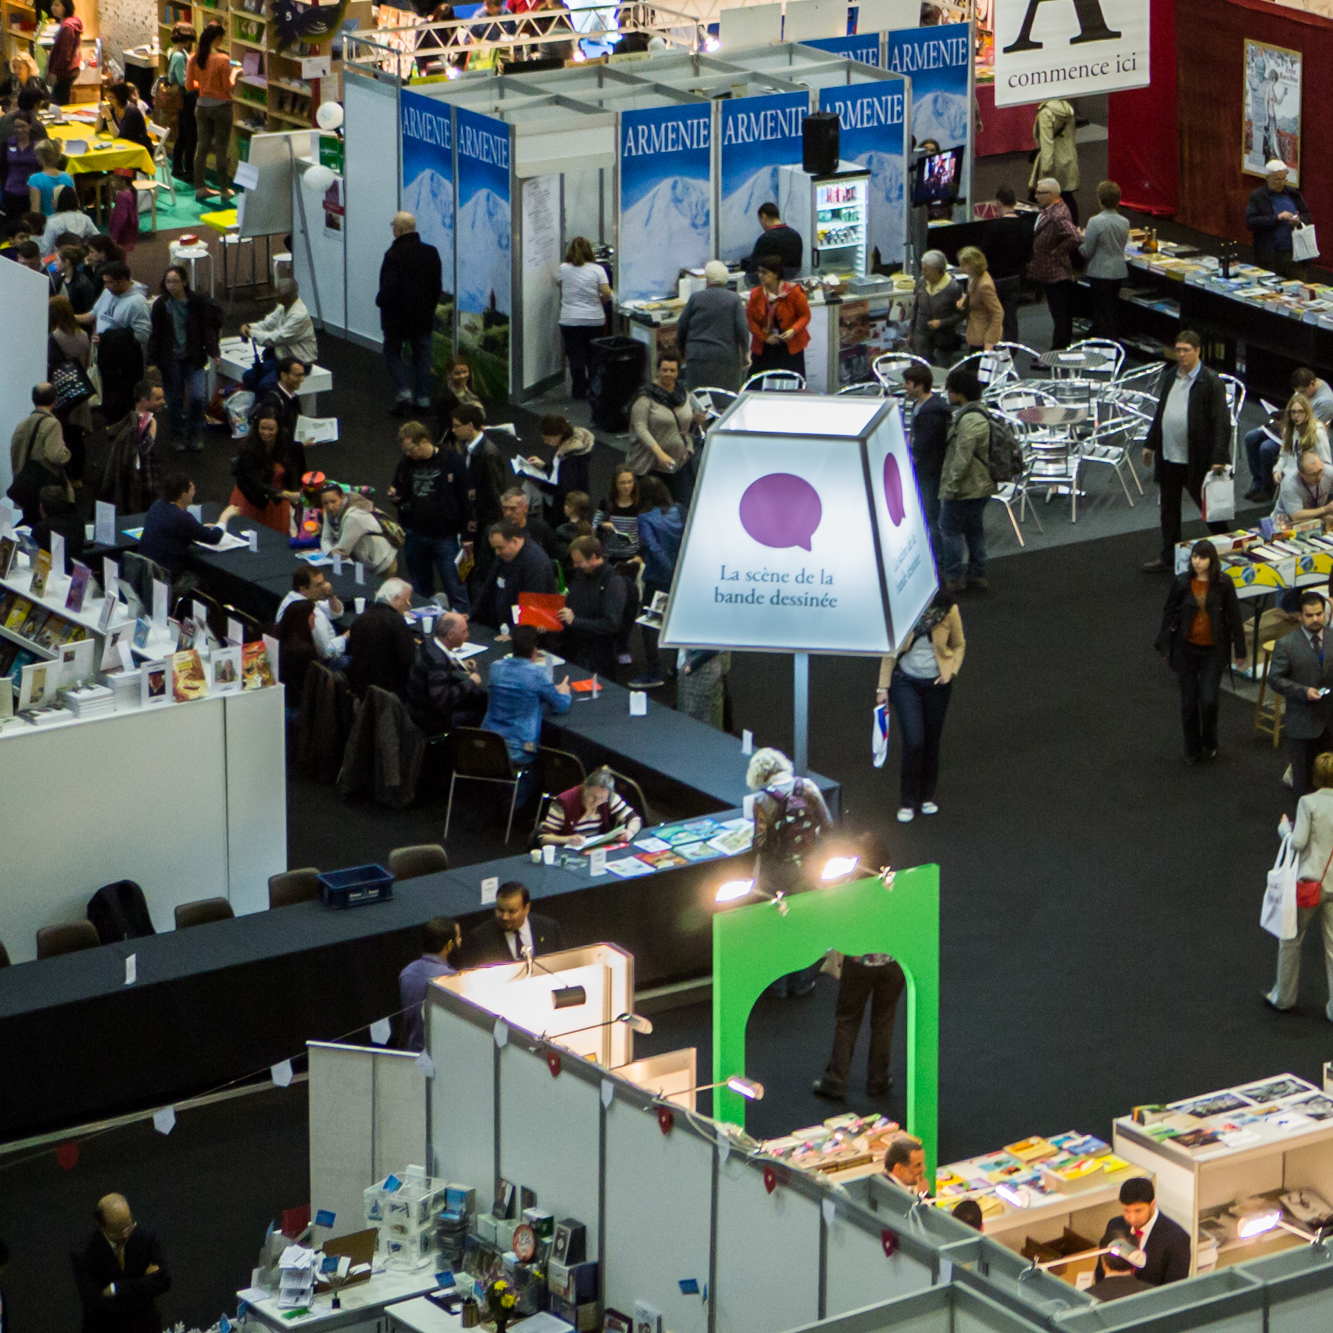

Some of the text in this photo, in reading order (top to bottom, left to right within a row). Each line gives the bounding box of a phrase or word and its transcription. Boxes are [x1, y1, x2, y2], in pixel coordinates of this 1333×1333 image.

[889, 35, 968, 71] ARMENIE
[1008, 52, 1137, 88] commence ici
[402, 112, 451, 148] ARMENIE
[623, 119, 710, 157] ARMENIE
[458, 128, 509, 169] ARMENIE
[720, 564, 834, 585] La scène de la
[713, 587, 838, 608] bande dessinée
